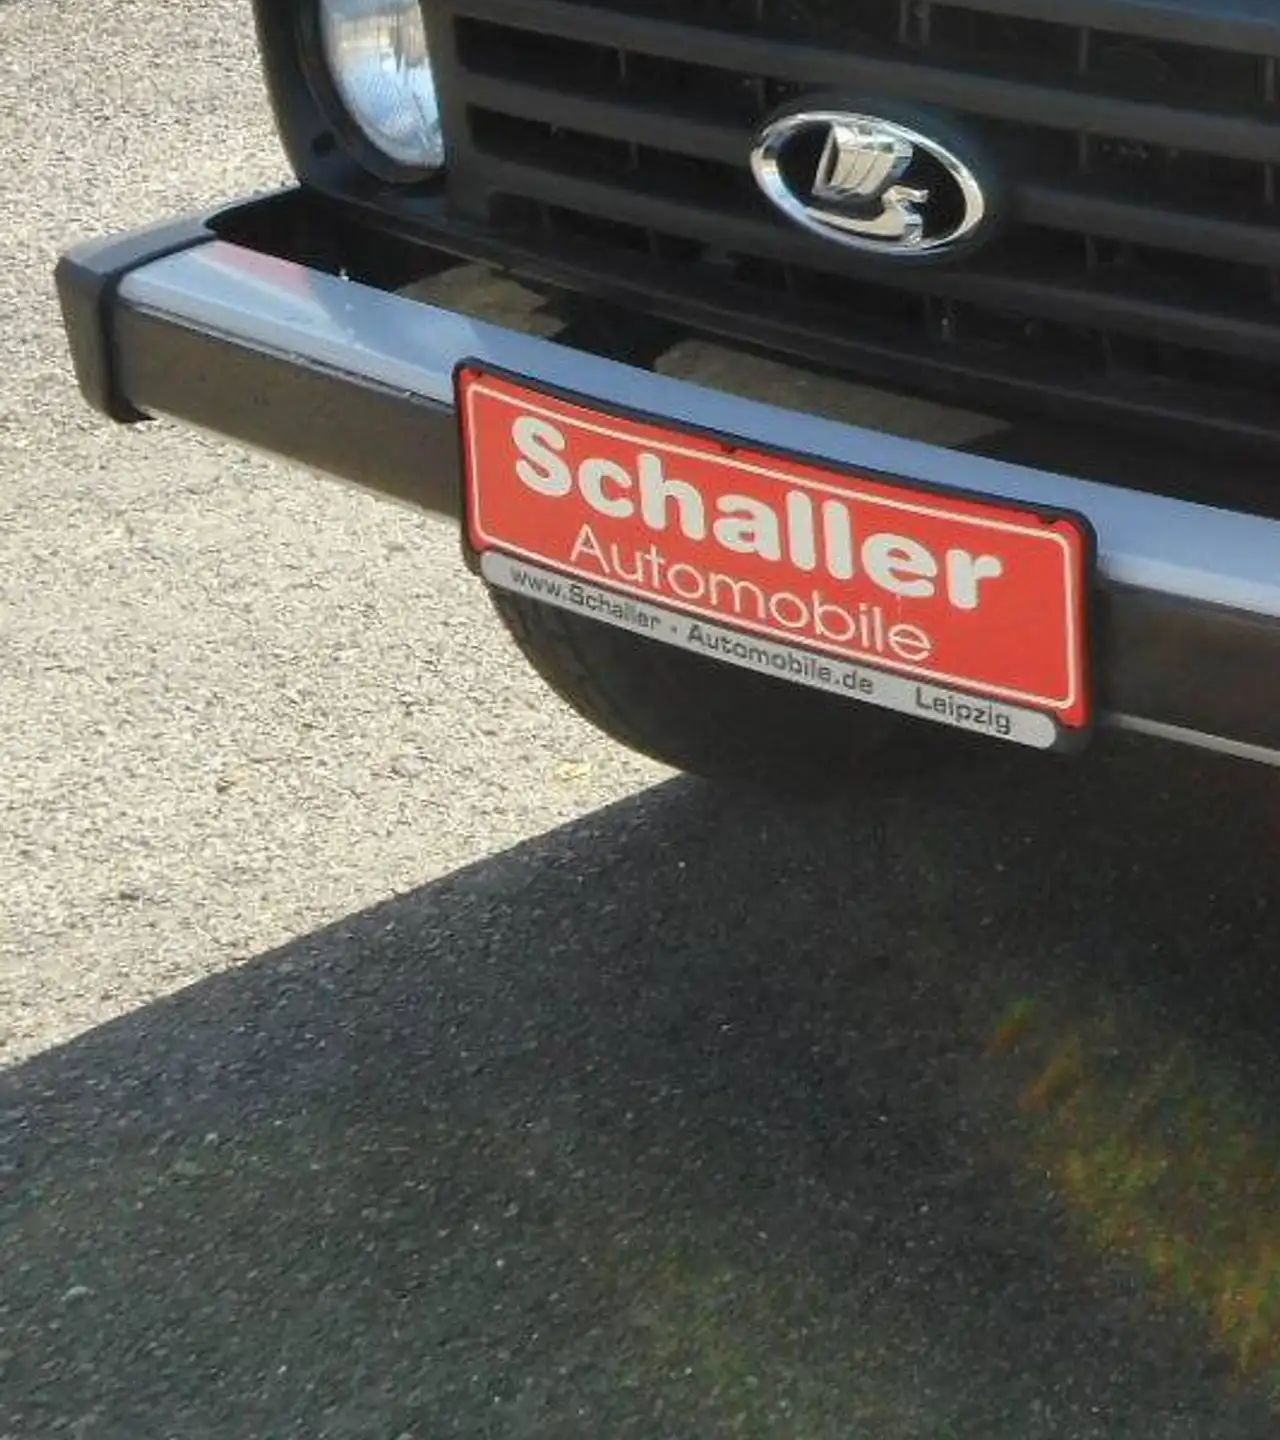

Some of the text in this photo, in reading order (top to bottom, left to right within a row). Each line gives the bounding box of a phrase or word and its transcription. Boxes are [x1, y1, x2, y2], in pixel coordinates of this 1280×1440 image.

[511, 415, 1003, 610] Schaller
[569, 523, 933, 662] Automobile
[914, 686, 1012, 737] Leipzig
